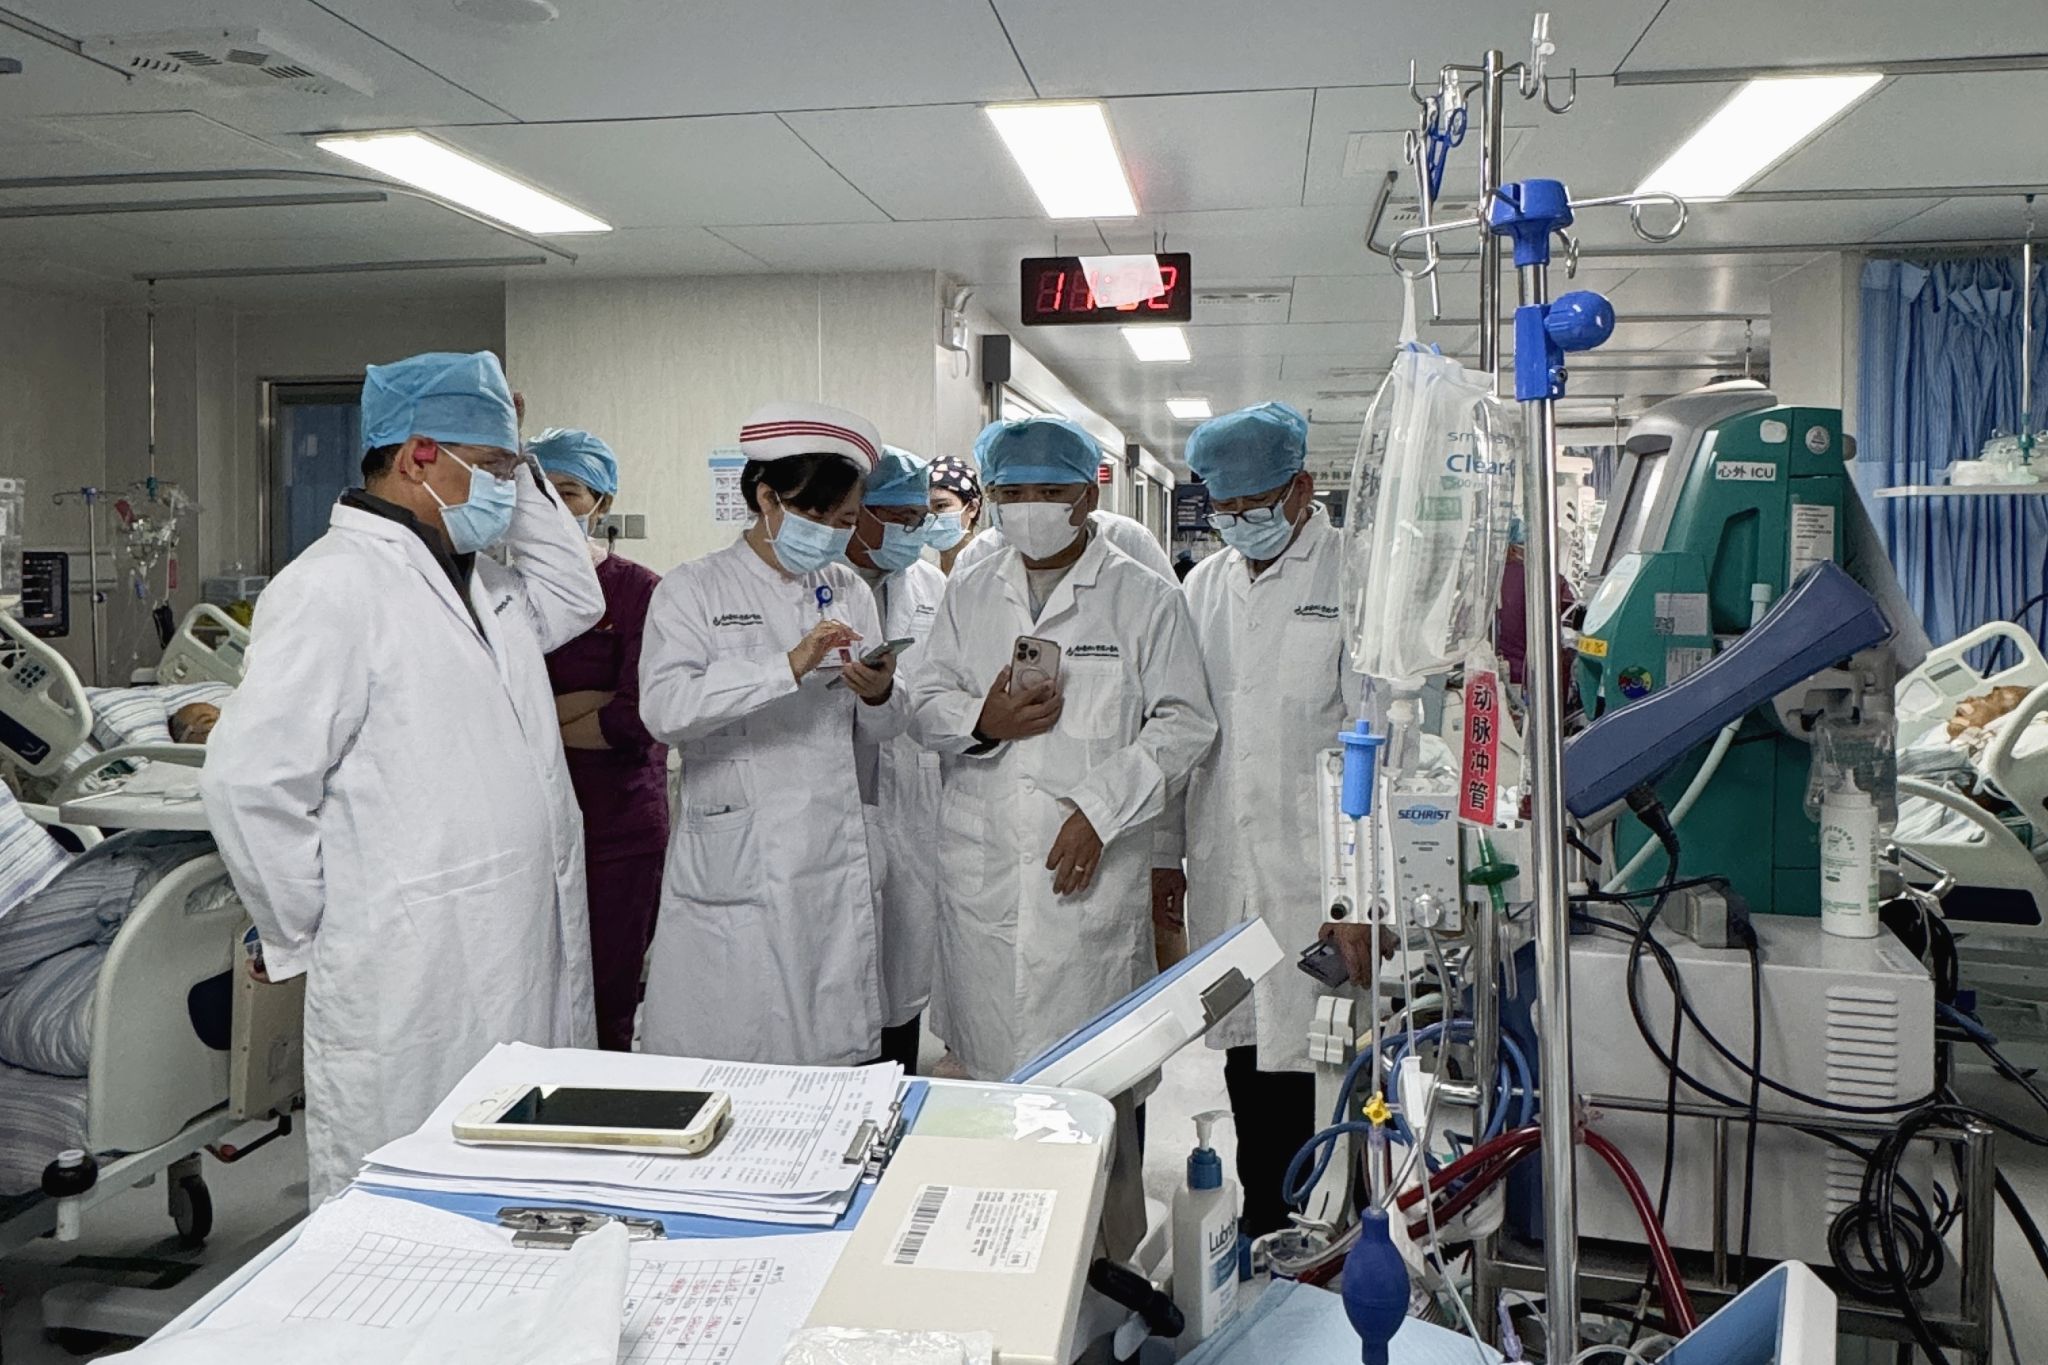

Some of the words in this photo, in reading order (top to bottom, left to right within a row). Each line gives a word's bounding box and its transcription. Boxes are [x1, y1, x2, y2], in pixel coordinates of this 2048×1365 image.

[1053, 265, 1177, 311] 11:2
[1718, 465, 1746, 479] 心外
[1751, 467, 1774, 479] ICU
[1468, 685, 1492, 811] 动脉冲管
[1397, 809, 1452, 821] SECHRIST
